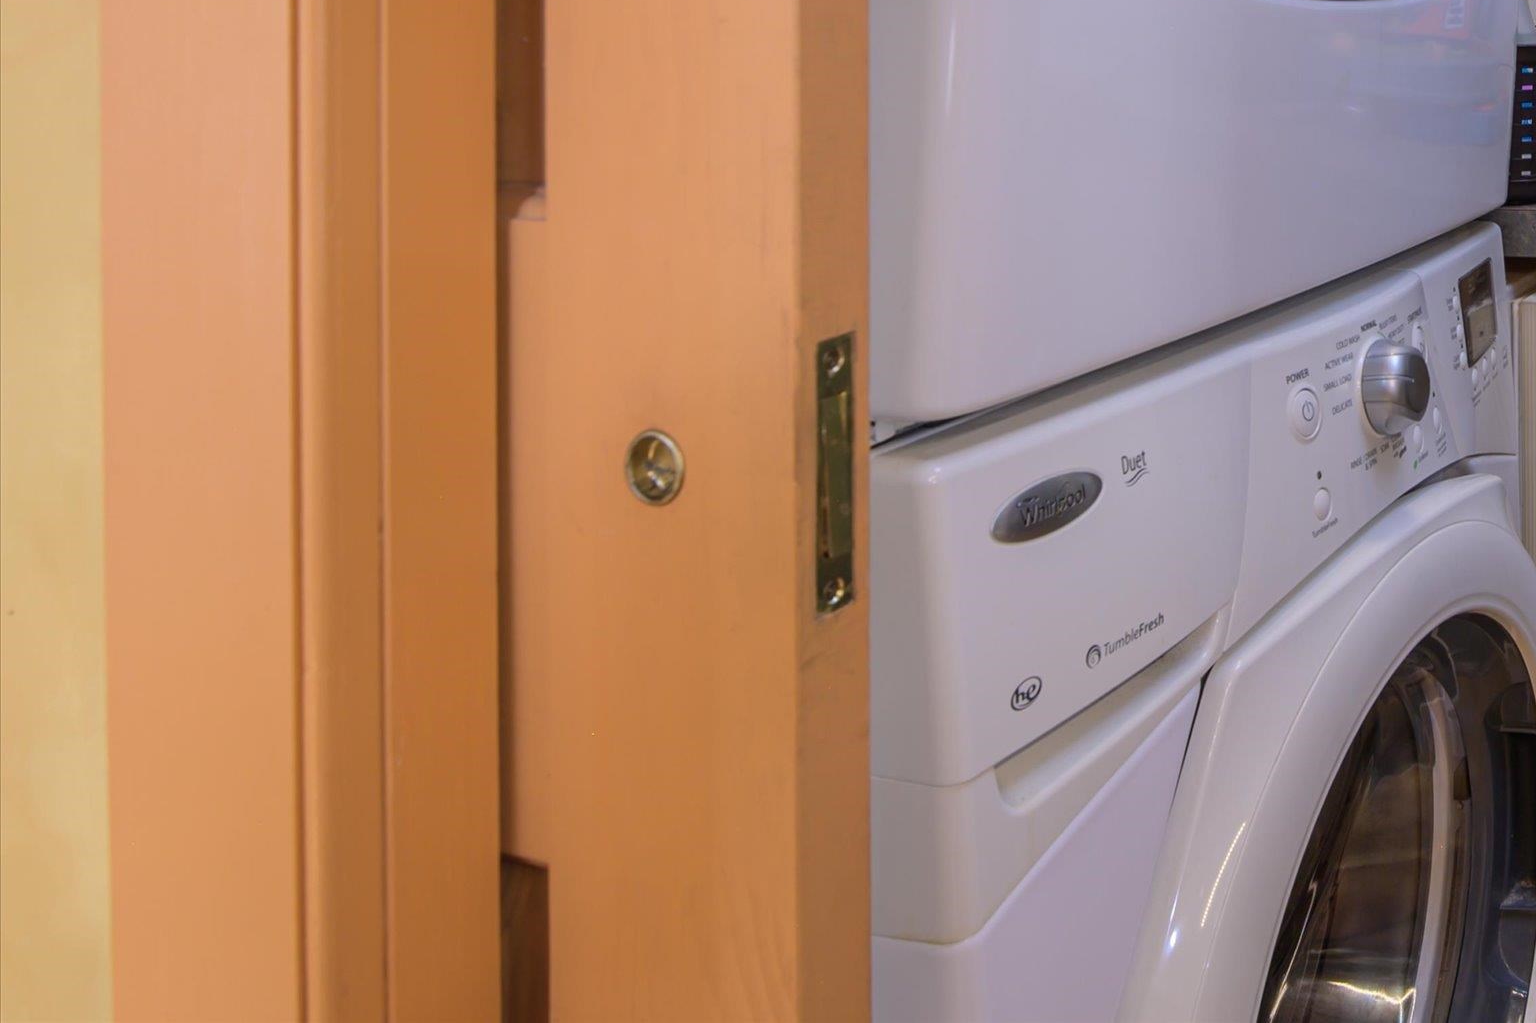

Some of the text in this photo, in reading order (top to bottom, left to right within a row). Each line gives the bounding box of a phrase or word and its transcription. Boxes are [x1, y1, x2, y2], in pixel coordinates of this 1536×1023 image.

[1286, 368, 1309, 384] POWER
[1323, 380, 1338, 392] SMALL
[1331, 399, 1353, 416] DELICATE
[1120, 450, 1147, 475] Duet
[1019, 483, 1087, 526] Whirlpool
[1103, 612, 1165, 657] TumbleFresh
